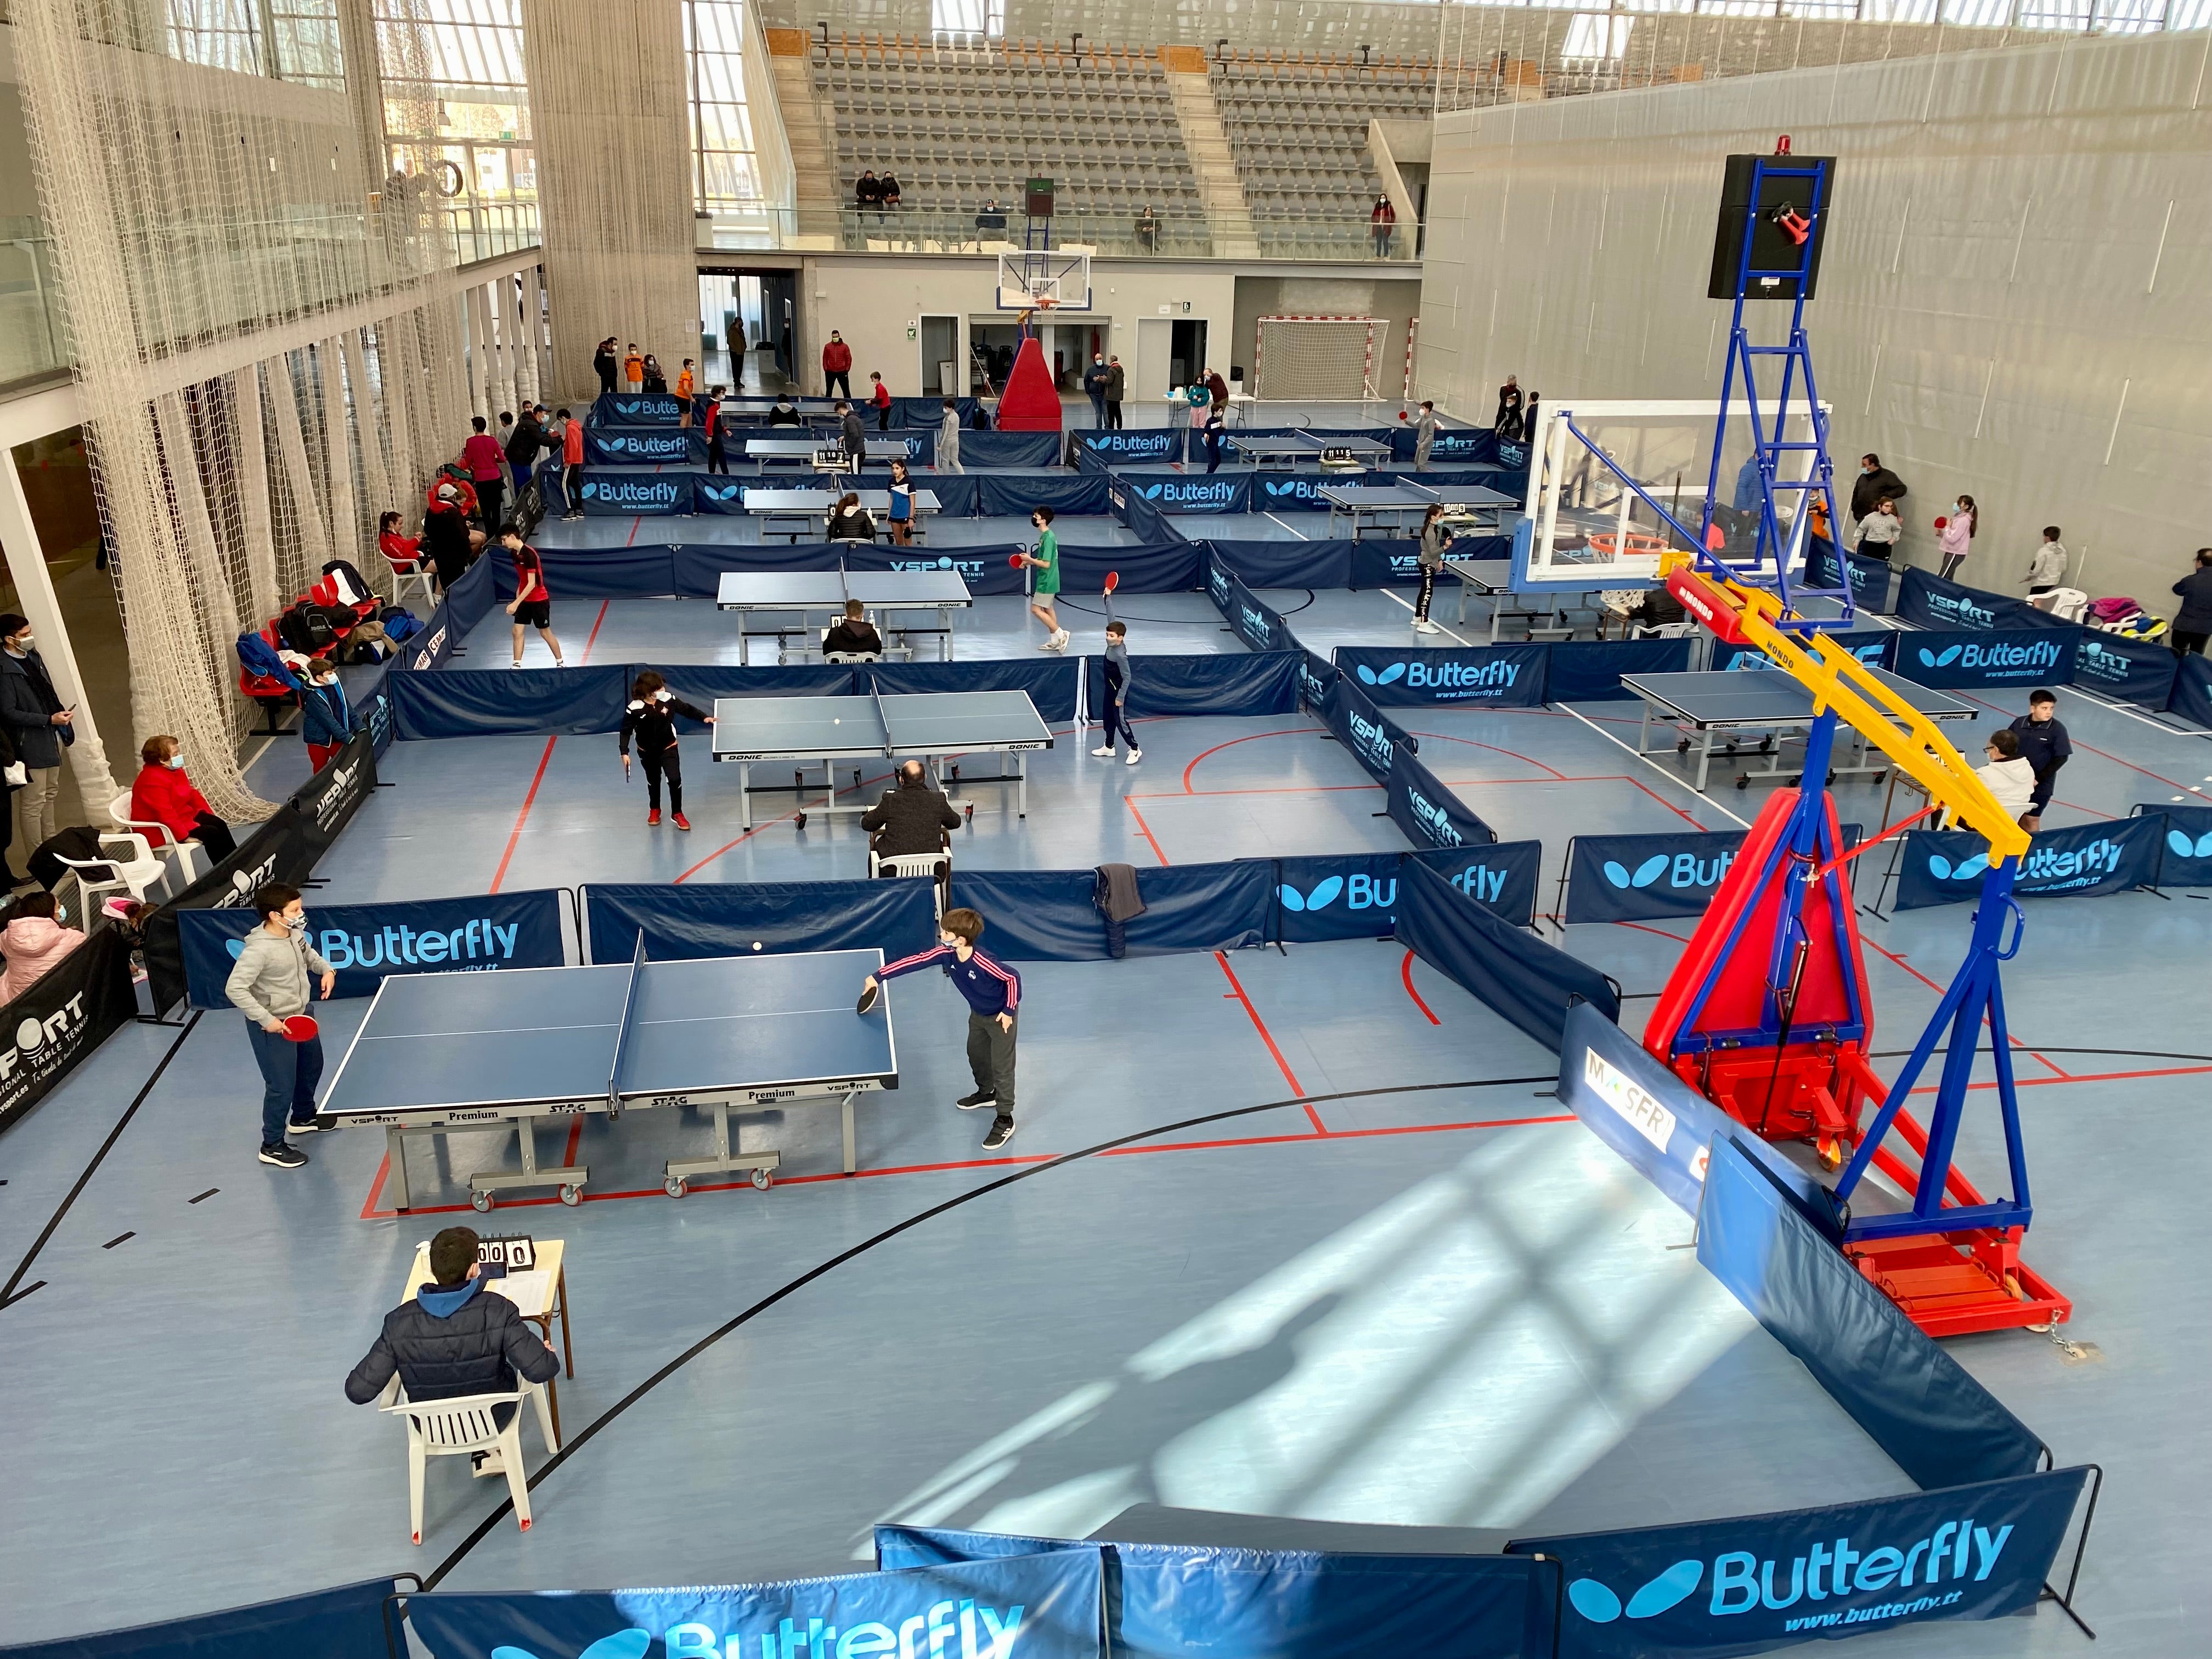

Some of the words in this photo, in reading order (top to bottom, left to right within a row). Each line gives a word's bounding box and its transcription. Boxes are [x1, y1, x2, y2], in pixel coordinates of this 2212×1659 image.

[642, 400, 679, 414] Butte
[1113, 435, 1171, 450] Butterfly
[600, 483, 678, 502] Butterfly
[1164, 482, 1235, 501] Butterfly
[830, 507, 836, 516] 0
[889, 556, 984, 572] VSPORT
[1684, 591, 1713, 621] MONDO
[1926, 591, 1995, 622] VSPORT
[1928, 603, 1959, 618] PROFESSIONAL
[1978, 620, 1994, 629] TENNIS
[1242, 604, 1269, 637] VSPORT
[1767, 640, 1794, 669] MONDO
[1962, 641, 2062, 667] Butterfly
[1408, 660, 1521, 687] Butterfly
[1436, 689, 1503, 698] www.butterfly.tt
[2015, 838, 2125, 881] utterfly
[320, 918, 518, 969] Butterfly
[0, 991, 83, 1081] PORT
[31, 1042, 63, 1068] TABLE
[65, 1014, 89, 1042] TENNIS
[748, 1090, 795, 1099] Premium
[827, 1082, 871, 1091] VSPORT
[0, 1084, 29, 1114] .vsport.es
[549, 1103, 586, 1114] STAG
[651, 1096, 687, 1107] STAG
[351, 1115, 399, 1124] VSPORT
[449, 1110, 499, 1121] Premium
[513, 1246, 526, 1265] 0
[1709, 1519, 2015, 1616] Butterfly
[1785, 1590, 1963, 1633] www.butterfly.tt
